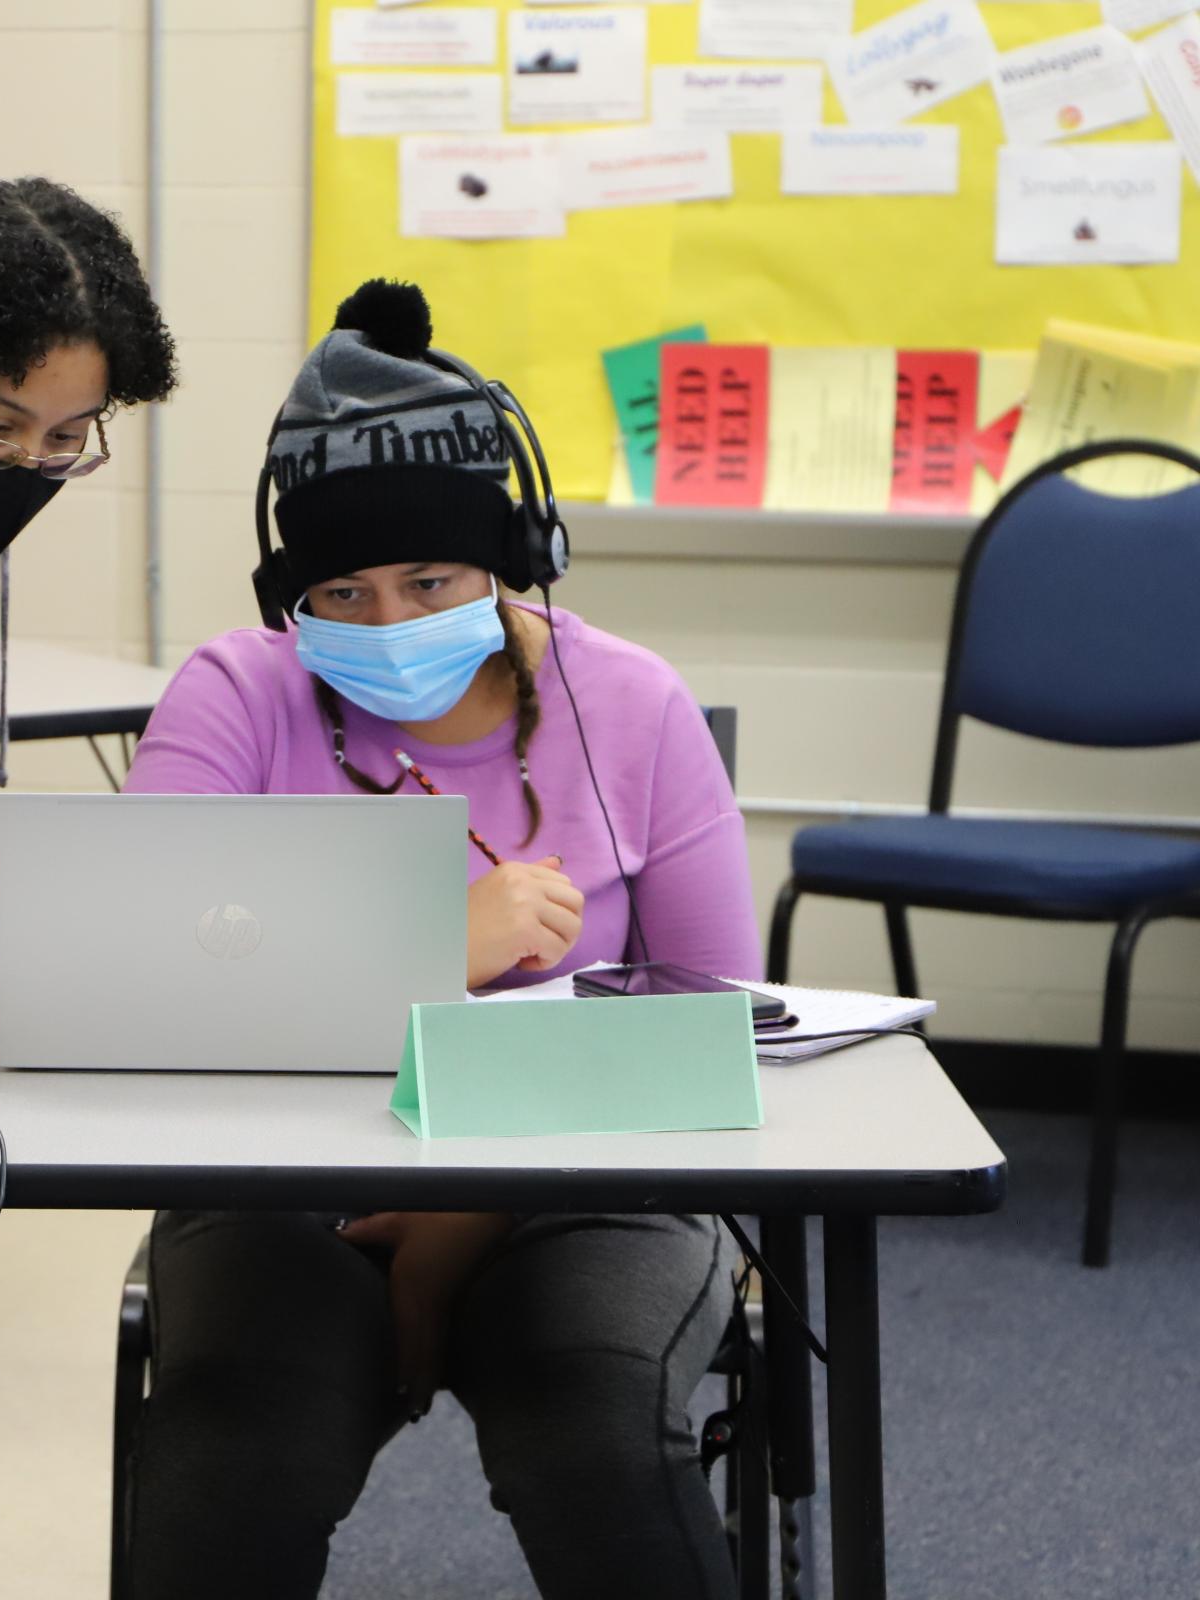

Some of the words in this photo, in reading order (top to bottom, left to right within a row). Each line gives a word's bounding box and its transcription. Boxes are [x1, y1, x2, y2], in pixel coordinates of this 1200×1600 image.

[672, 367, 708, 482] NEED
[717, 367, 751, 482] HELP
[922, 373, 958, 487] HELP
